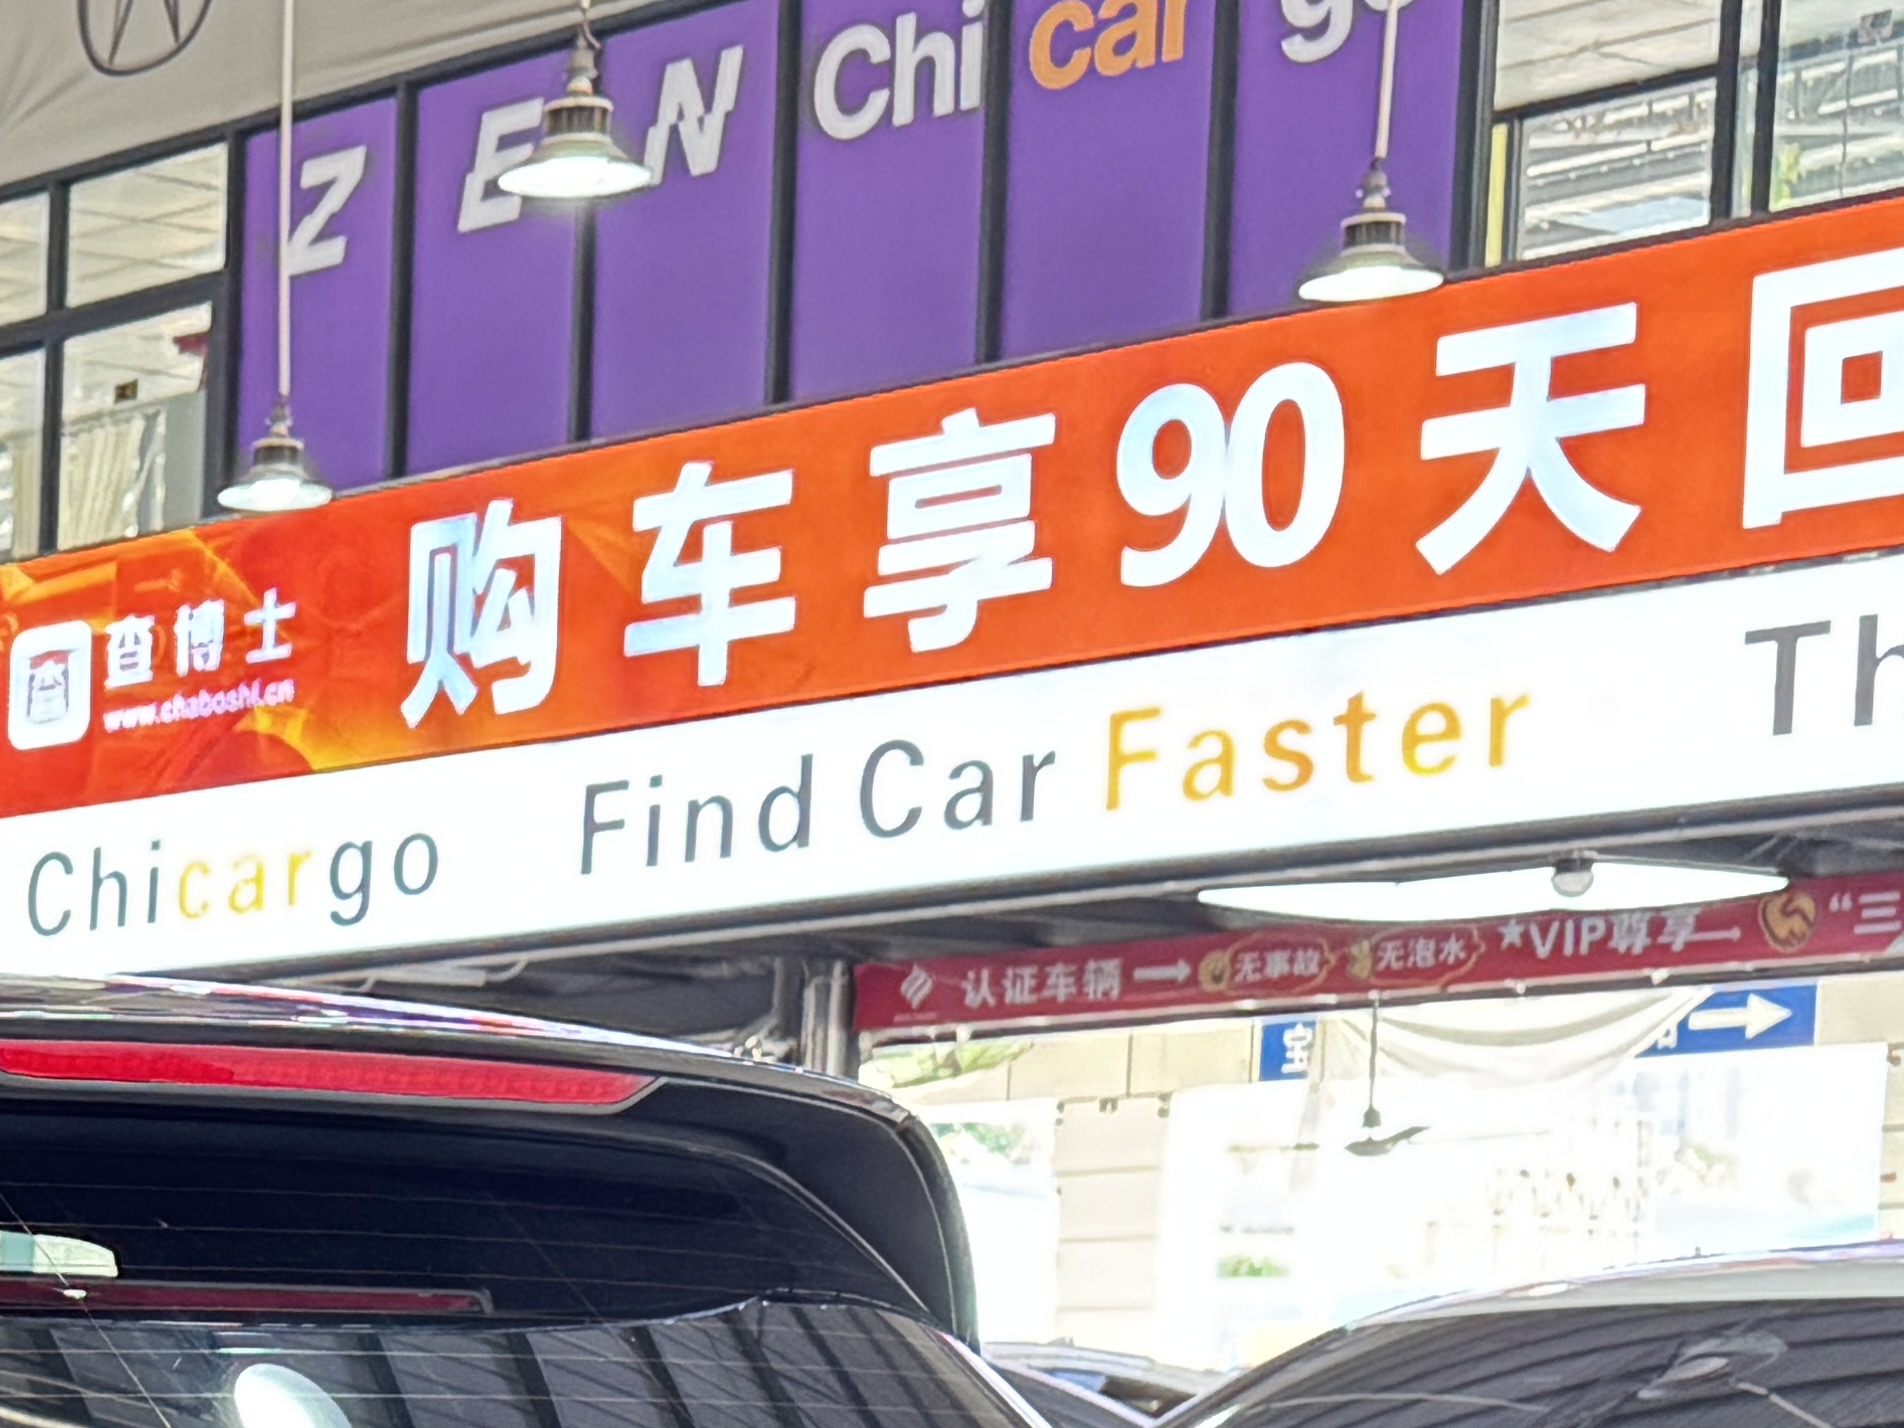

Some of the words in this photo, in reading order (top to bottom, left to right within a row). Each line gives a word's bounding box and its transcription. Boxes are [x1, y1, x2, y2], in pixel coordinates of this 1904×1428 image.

[104, 587, 297, 690] 查博士
[103, 678, 295, 733] www.chaboshi.cn
[27, 833, 439, 937] Chicargo
[580, 753, 814, 876] Find
[858, 738, 1056, 839] Car
[1104, 690, 1532, 812] Faster
[961, 958, 1123, 1009] 认证车辆
[1236, 947, 1320, 983] 无事故
[1376, 934, 1467, 971] 无泡水
